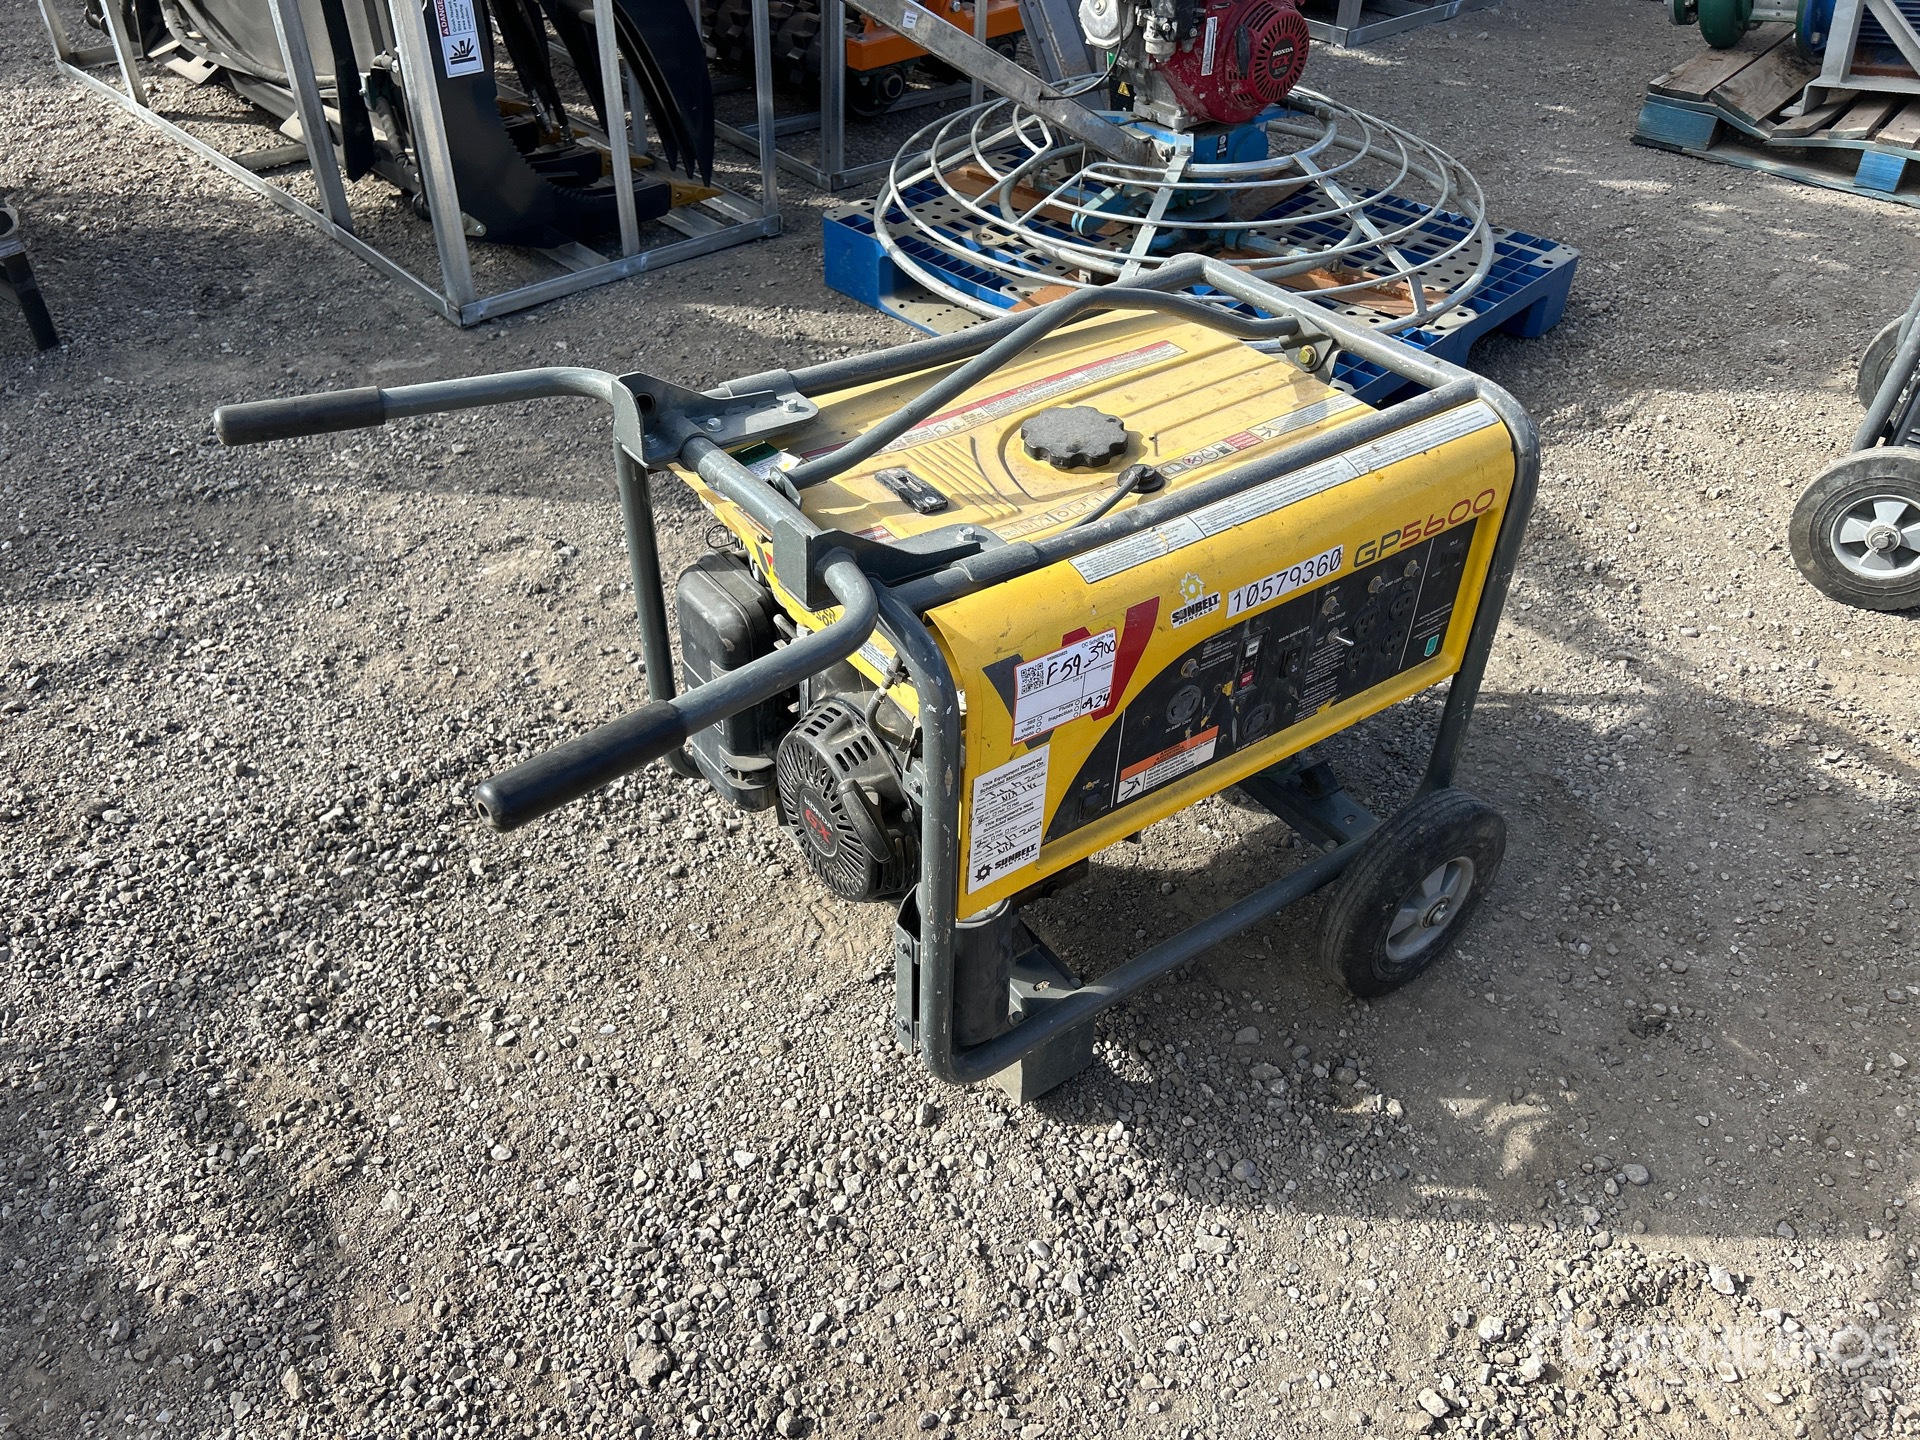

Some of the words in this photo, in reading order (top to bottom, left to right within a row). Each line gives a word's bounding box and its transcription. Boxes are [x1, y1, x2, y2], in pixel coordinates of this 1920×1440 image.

[437, 0, 448, 28] DANGE
[1272, 46, 1294, 57] HONDA
[1353, 488, 1496, 568] GP5600
[1233, 548, 1342, 613] 10579360
[1178, 606, 1213, 626] RENTALS
[1081, 641, 1089, 649] OC
[1278, 632, 1289, 643] MAIN
[1289, 625, 1310, 639] BREAKER
[1048, 708, 1074, 722] Inspection
[979, 779, 1005, 794] Scheduled
[1005, 766, 1036, 783] Maintenance
[982, 780, 993, 788] This
[993, 767, 1020, 782] Equipment
[1020, 757, 1043, 770] Received
[804, 795, 834, 832] HONDA
[805, 808, 833, 846] GX
[983, 819, 1006, 833] Scheduled
[1006, 806, 1034, 823] Maintenance
[1000, 853, 1030, 870] RENTALS
